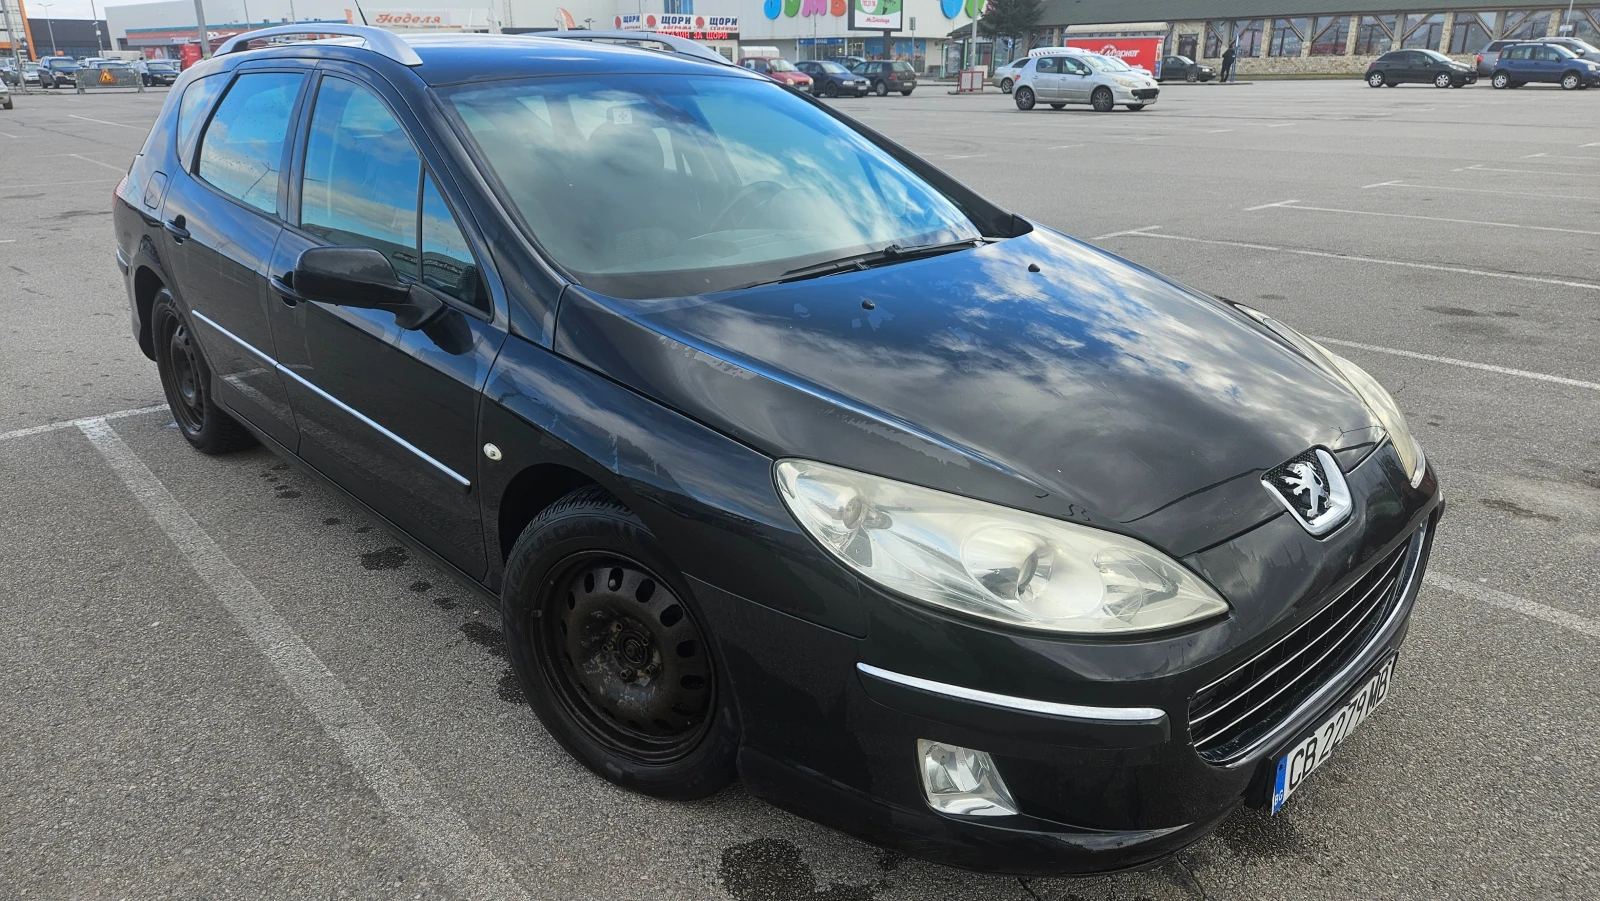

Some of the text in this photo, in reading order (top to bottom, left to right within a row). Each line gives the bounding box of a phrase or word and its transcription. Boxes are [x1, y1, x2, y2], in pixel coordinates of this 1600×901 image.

[375, 13, 441, 23] Неделя
[623, 15, 640, 24] ЩОРИ
[661, 16, 691, 25] ЩОРИ
[709, 17, 738, 26] ЩОРИ
[693, 31, 703, 39] ЗА
[706, 32, 728, 40] ЩОРИ
[1289, 665, 1389, 791] CB 2279 MB
[1274, 789, 1284, 806] BG
